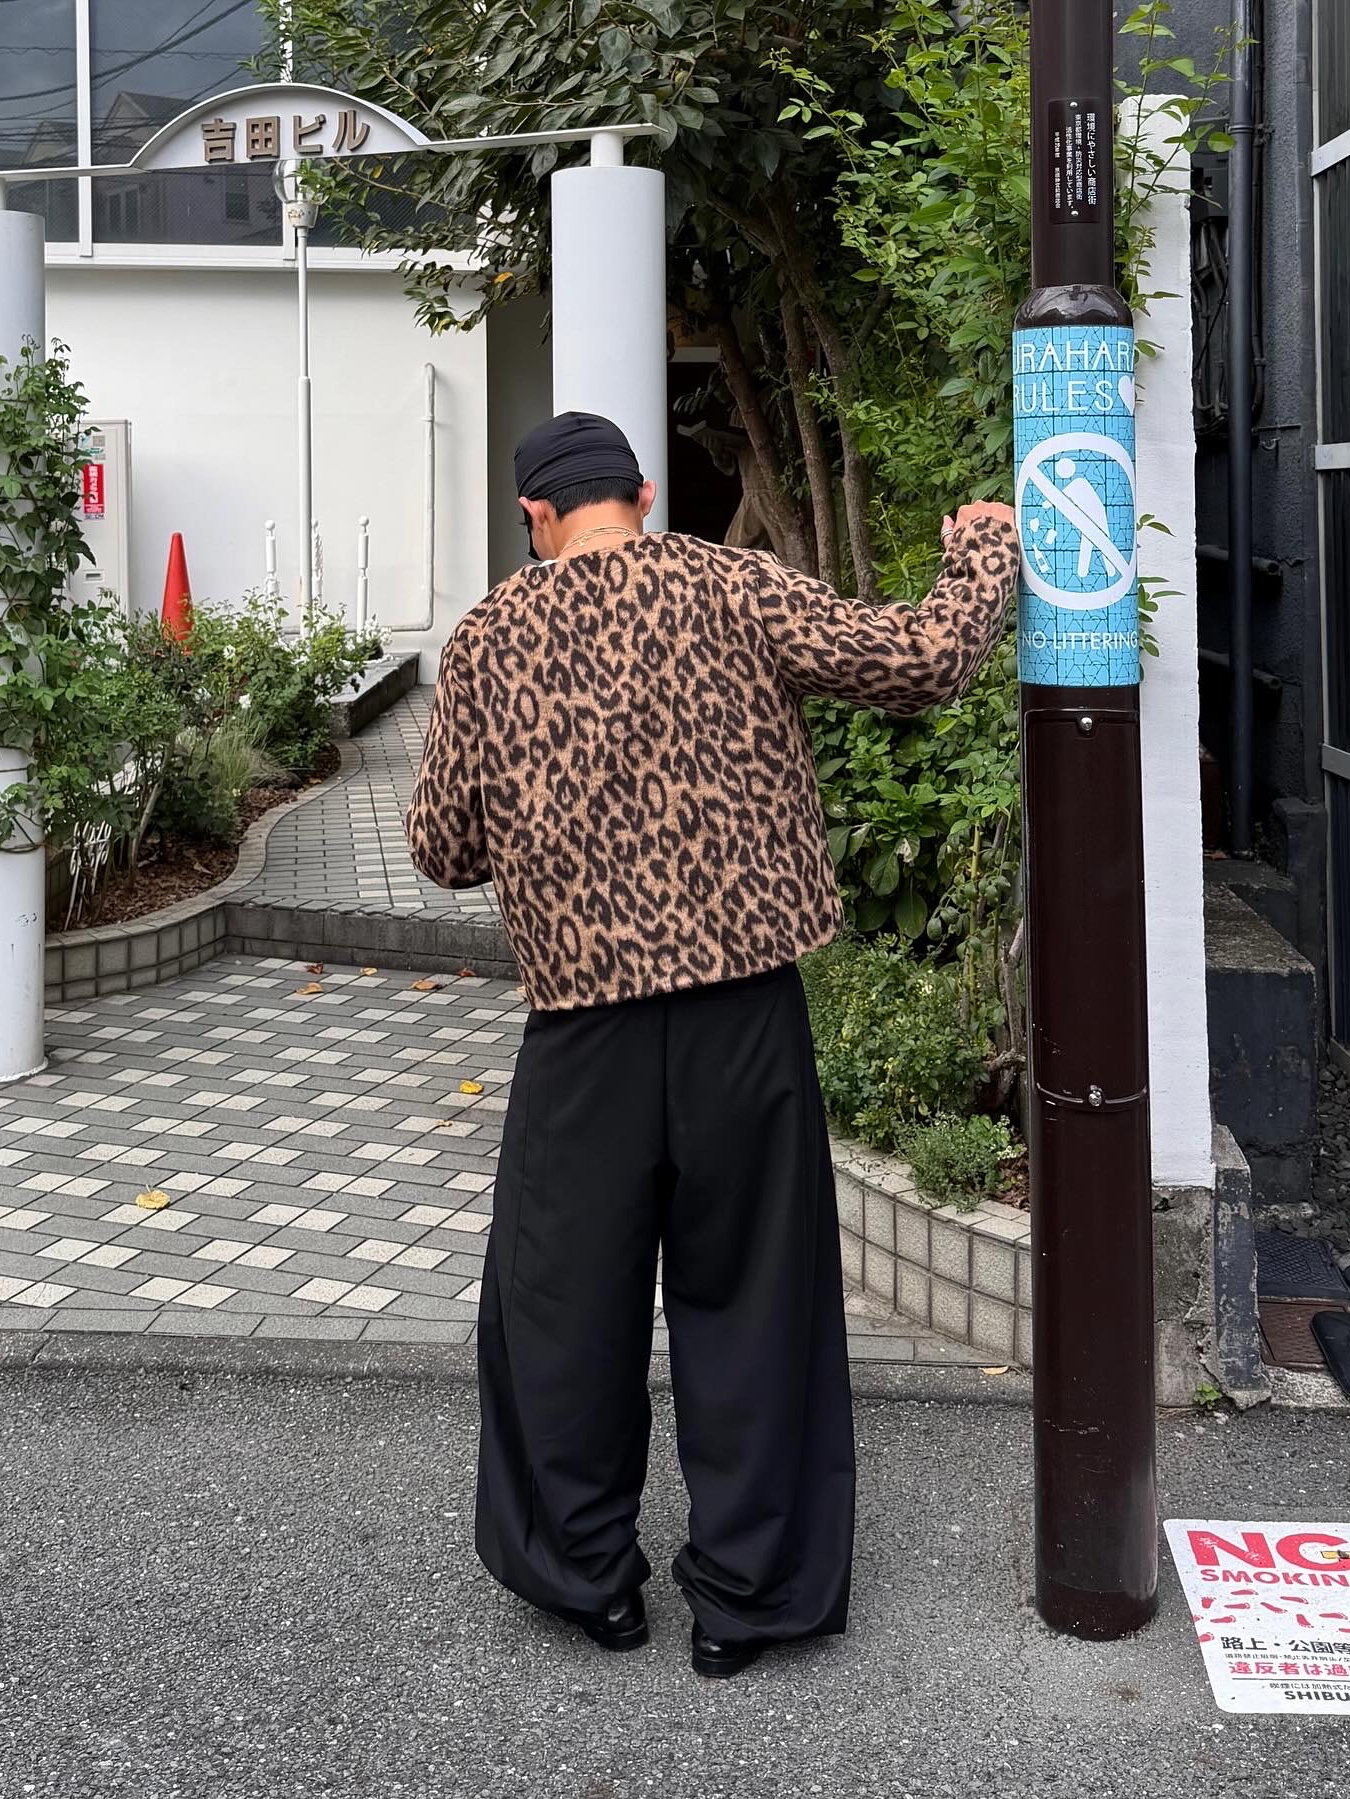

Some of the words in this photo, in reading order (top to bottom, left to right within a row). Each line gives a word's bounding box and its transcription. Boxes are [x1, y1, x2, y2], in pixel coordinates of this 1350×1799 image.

[201, 110, 370, 163] 吉田ビル
[1086, 113, 1097, 205] 環境にやさしい商店街
[1012, 340, 1135, 374] URAHAR
[1013, 380, 1114, 418] RULES
[1021, 631, 1046, 649] NO
[1053, 630, 1138, 650] LITTERING
[1228, 1661, 1350, 1677] 違反者は過
[1284, 1690, 1350, 1702] SHIBU
